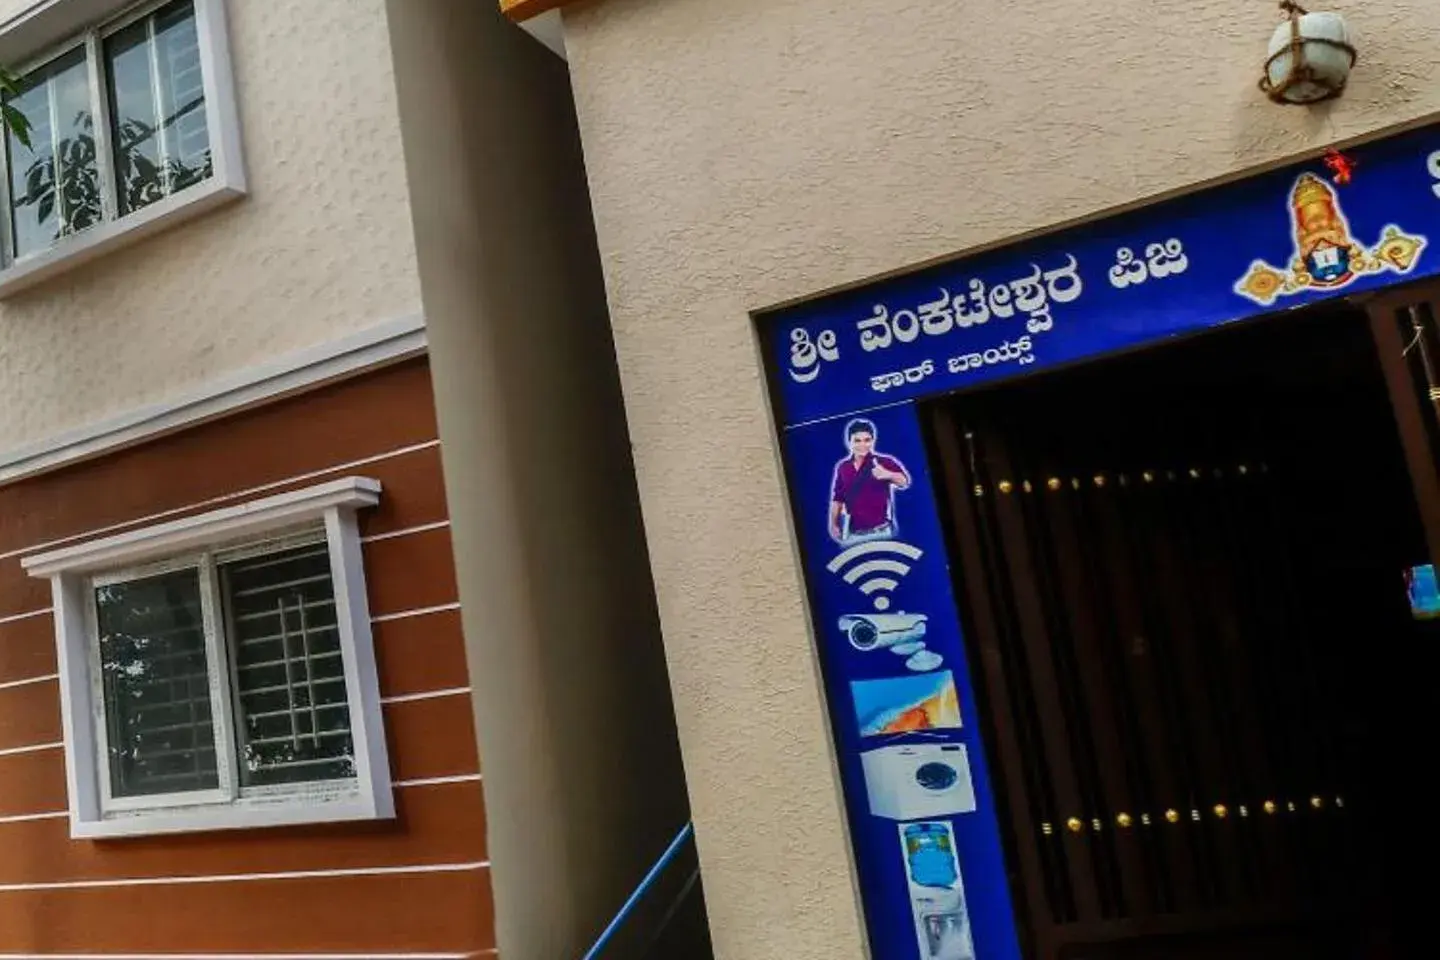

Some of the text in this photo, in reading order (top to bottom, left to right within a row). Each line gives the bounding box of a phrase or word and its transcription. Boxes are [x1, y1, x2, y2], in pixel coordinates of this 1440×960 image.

[788, 237, 1189, 384] ಶ್ರೀ ವೆಂಕಟೇಶ್ವರ ಪಿಜಿ
